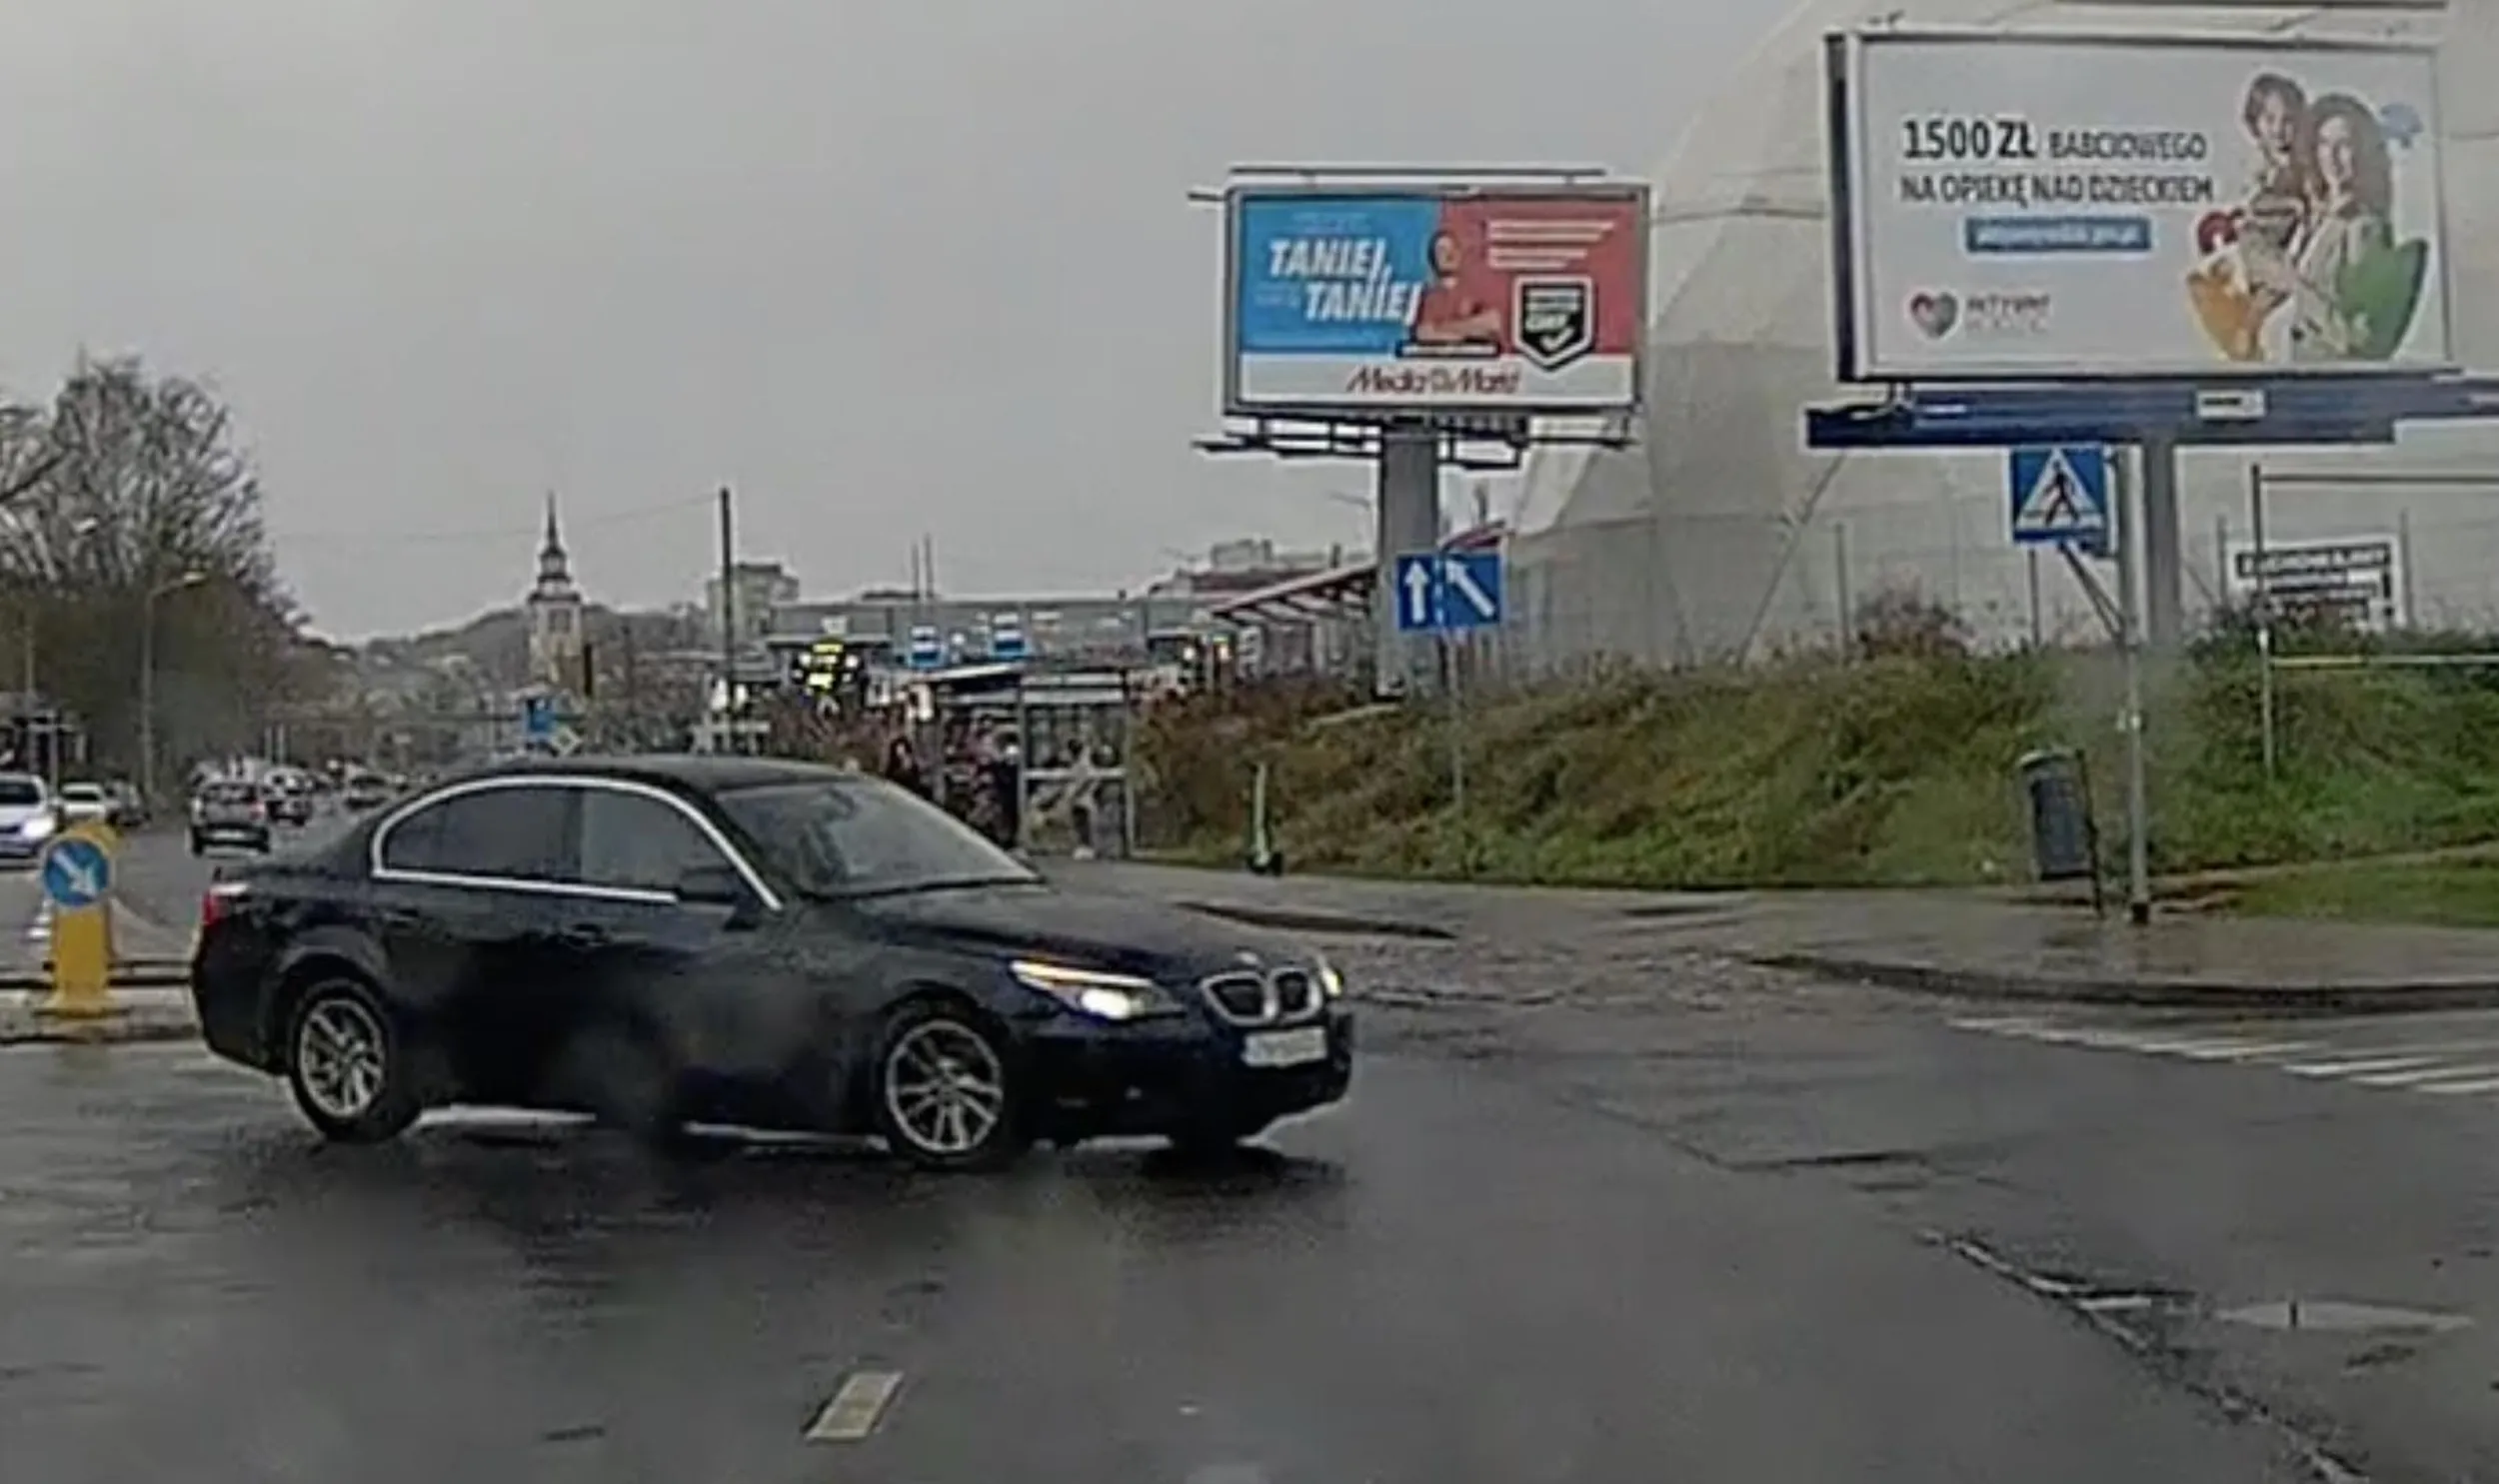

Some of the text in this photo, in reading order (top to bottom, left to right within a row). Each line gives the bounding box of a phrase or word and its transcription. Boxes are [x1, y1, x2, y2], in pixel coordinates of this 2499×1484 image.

[1903, 120, 1992, 159] 1500
[1901, 175, 1936, 201] NA
[2032, 175, 2083, 201] NAD
